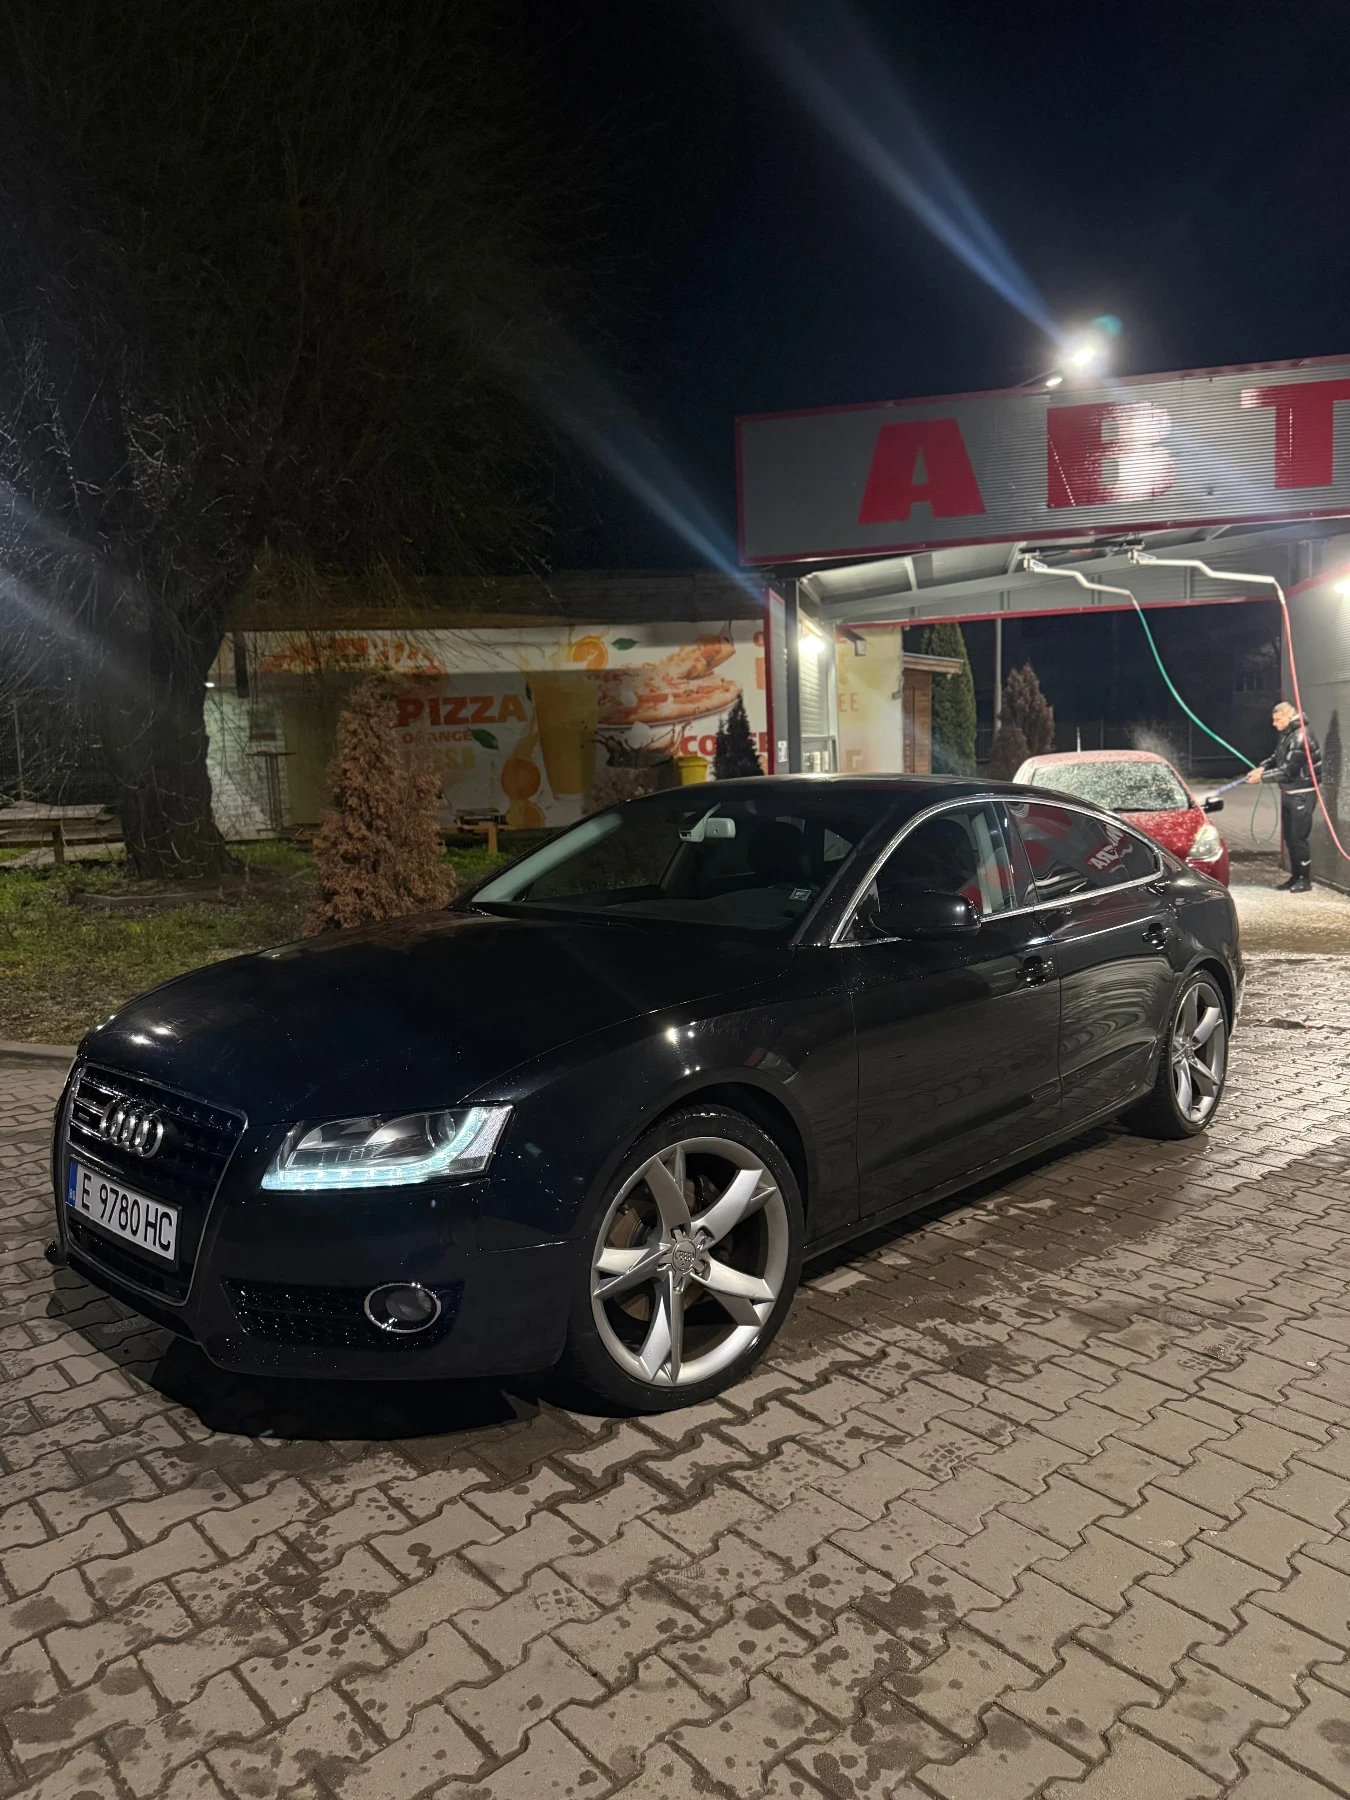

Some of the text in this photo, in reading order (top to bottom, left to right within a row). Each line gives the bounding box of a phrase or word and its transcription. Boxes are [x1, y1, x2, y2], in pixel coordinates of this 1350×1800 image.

[396, 694, 528, 727] PIZZA
[402, 730, 473, 744] OANGE
[81, 1172, 173, 1252] E 9780 HC
